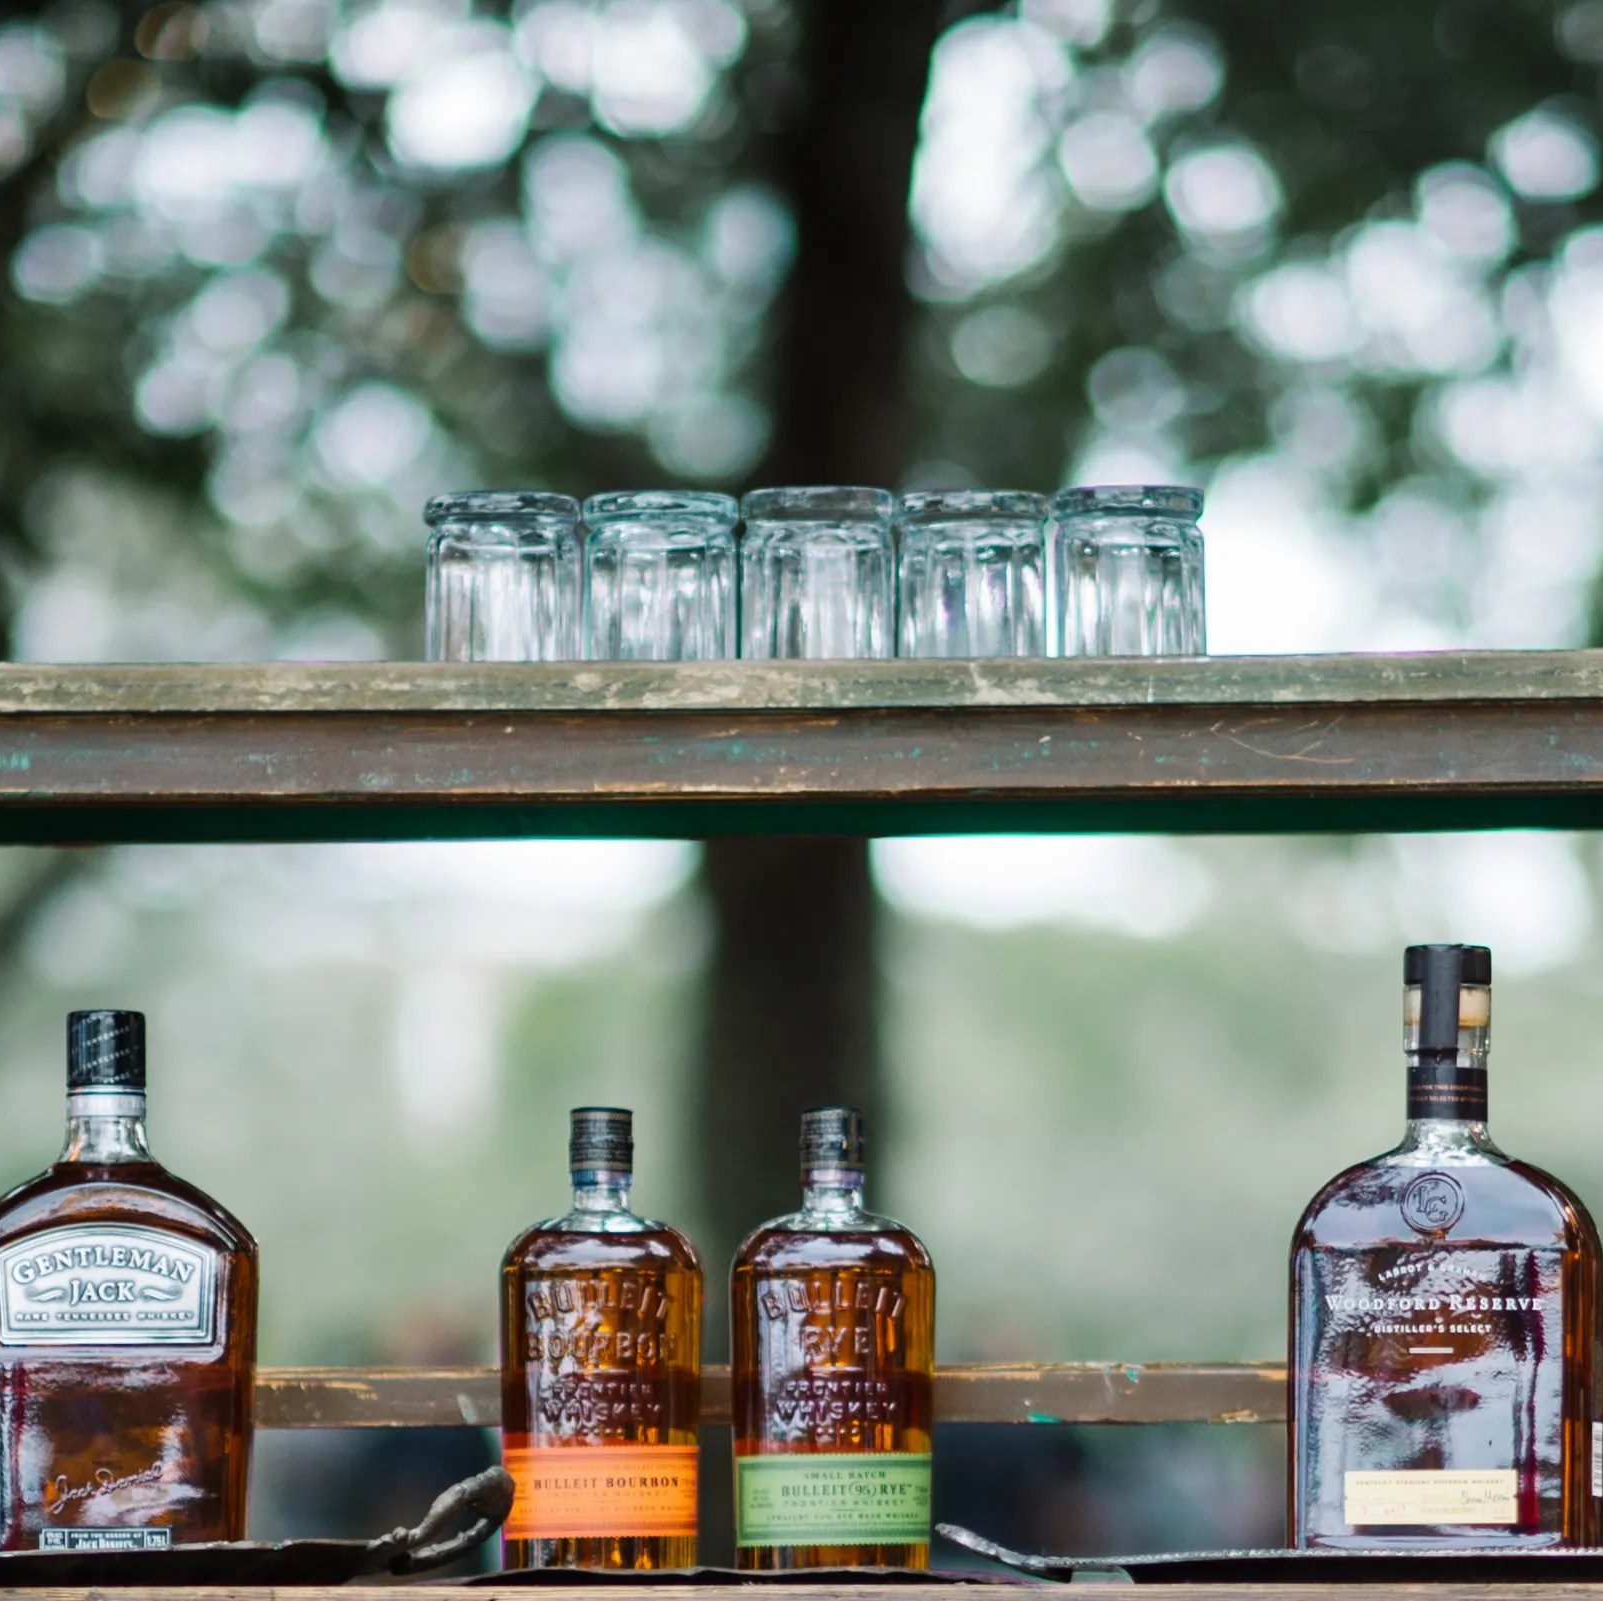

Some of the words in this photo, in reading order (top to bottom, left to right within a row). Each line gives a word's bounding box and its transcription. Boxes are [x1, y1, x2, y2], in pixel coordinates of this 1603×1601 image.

[11, 1245, 195, 1284] GENTLEMAN
[1378, 1264, 1422, 1281] LABROT
[69, 1278, 135, 1306] JACK
[527, 1280, 673, 1321] BULLEIT
[761, 1280, 903, 1321] BULLEIT
[1325, 1295, 1441, 1311] WOODFORD
[1449, 1294, 1543, 1311] RESERVE
[15, 1311, 49, 1322] RARE
[55, 1311, 132, 1322] TENNESSEE
[136, 1311, 195, 1322] WHISKEY
[1374, 1324, 1445, 1334] DISTILLER'S
[1449, 1324, 1492, 1334] SELECT
[527, 1329, 678, 1362] BOURBON
[802, 1326, 870, 1356] RYE
[533, 1478, 597, 1490] BULLEIT
[605, 1476, 679, 1489] BOURBON
[804, 1472, 843, 1480] SMALL
[848, 1471, 887, 1479] BATCH
[781, 1484, 846, 1497] BULLEIT
[854, 1484, 871, 1496] 95
[75, 1538, 98, 1549] JACK
